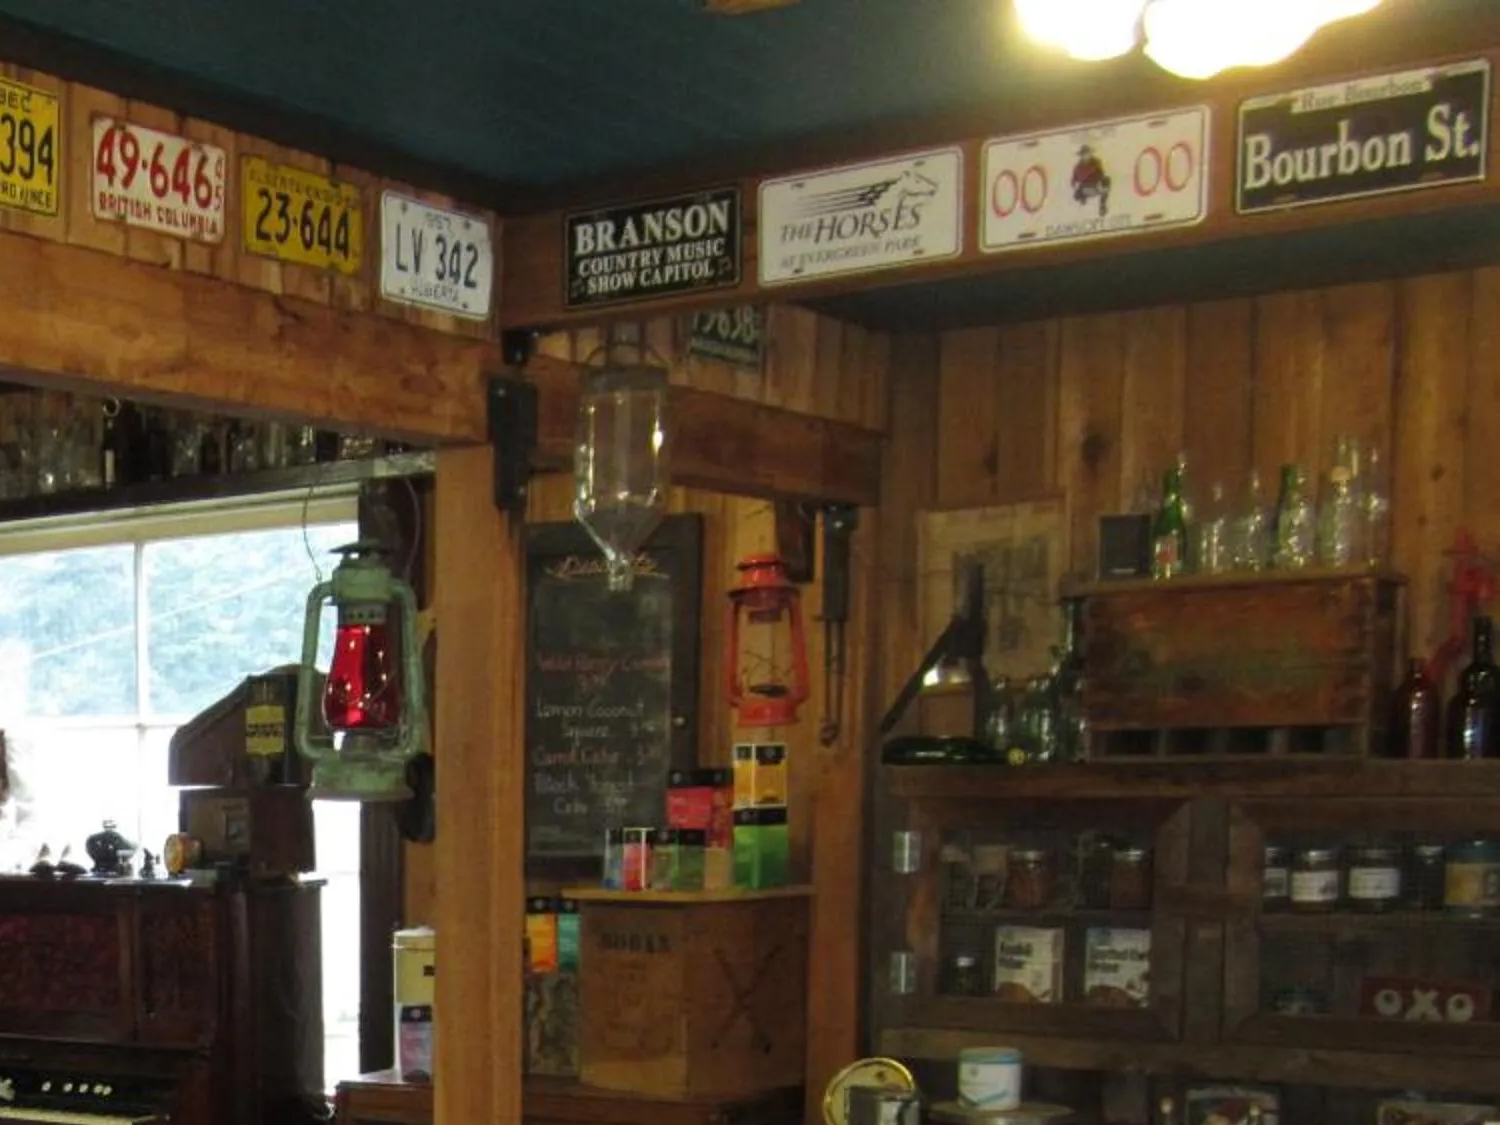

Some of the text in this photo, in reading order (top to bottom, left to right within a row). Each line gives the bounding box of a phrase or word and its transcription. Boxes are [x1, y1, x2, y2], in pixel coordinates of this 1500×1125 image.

[1244, 102, 1479, 190] Bourbon St.
[100, 191, 218, 234] BRITISH COLUMBIA
[574, 200, 731, 256] BRANSON
[781, 203, 927, 245] THE HORSES
[396, 222, 479, 289] LV 342
[578, 237, 726, 278] COUNTRY MUSIC
[587, 259, 714, 295] SHOW CAPITOL
[1373, 988, 1474, 1023] OXO
